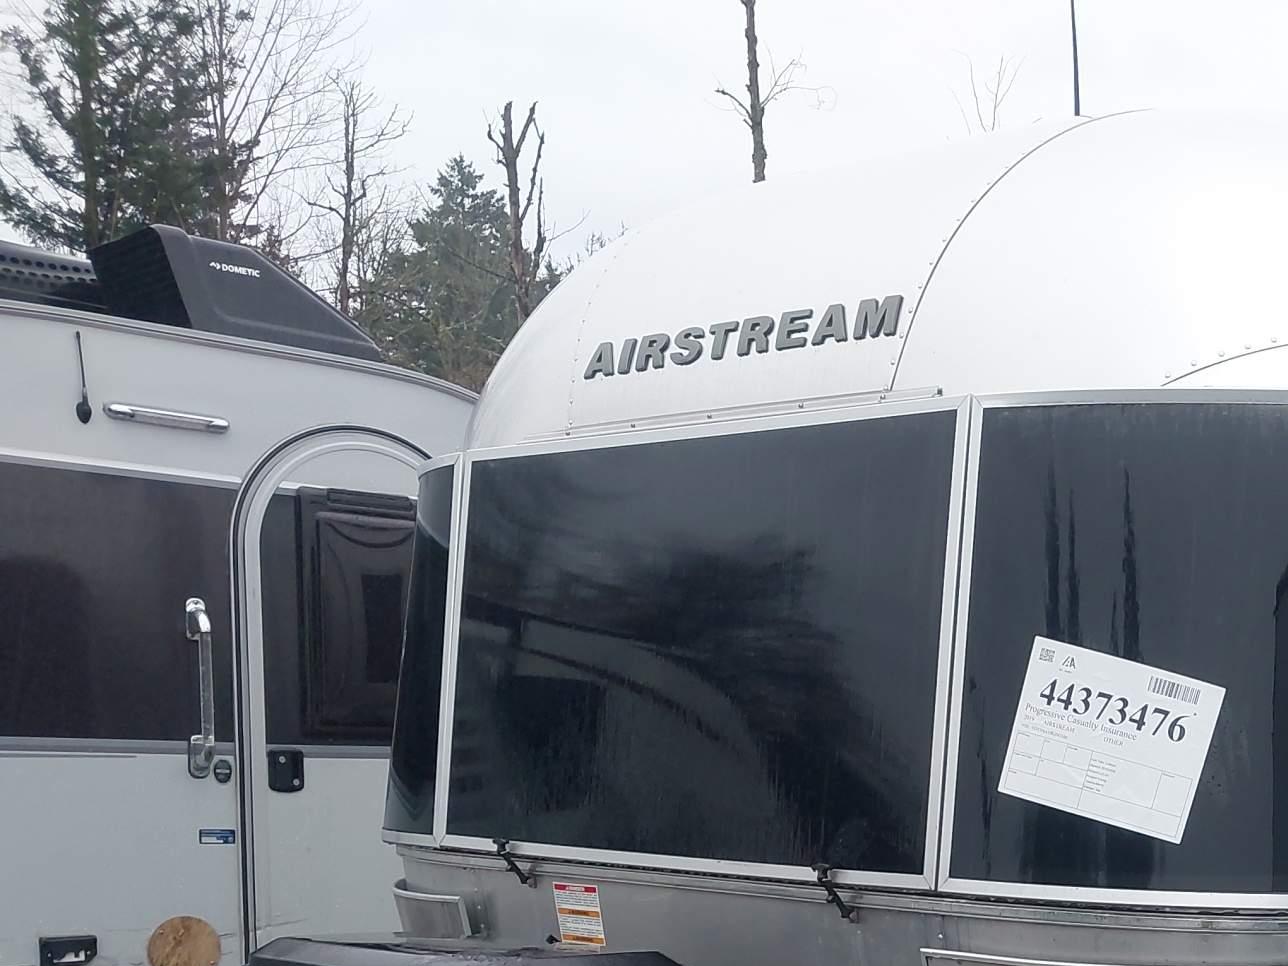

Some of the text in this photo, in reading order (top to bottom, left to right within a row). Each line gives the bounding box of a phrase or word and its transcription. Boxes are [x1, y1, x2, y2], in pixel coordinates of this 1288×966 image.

[221, 263, 261, 278] DOMETIC
[583, 294, 905, 380] AIRSTREAM
[1024, 702, 1066, 721] Progressive
[1066, 714, 1099, 731] Casualty
[1100, 723, 1137, 741] Insurance
[1039, 678, 1191, 742] 44373476
